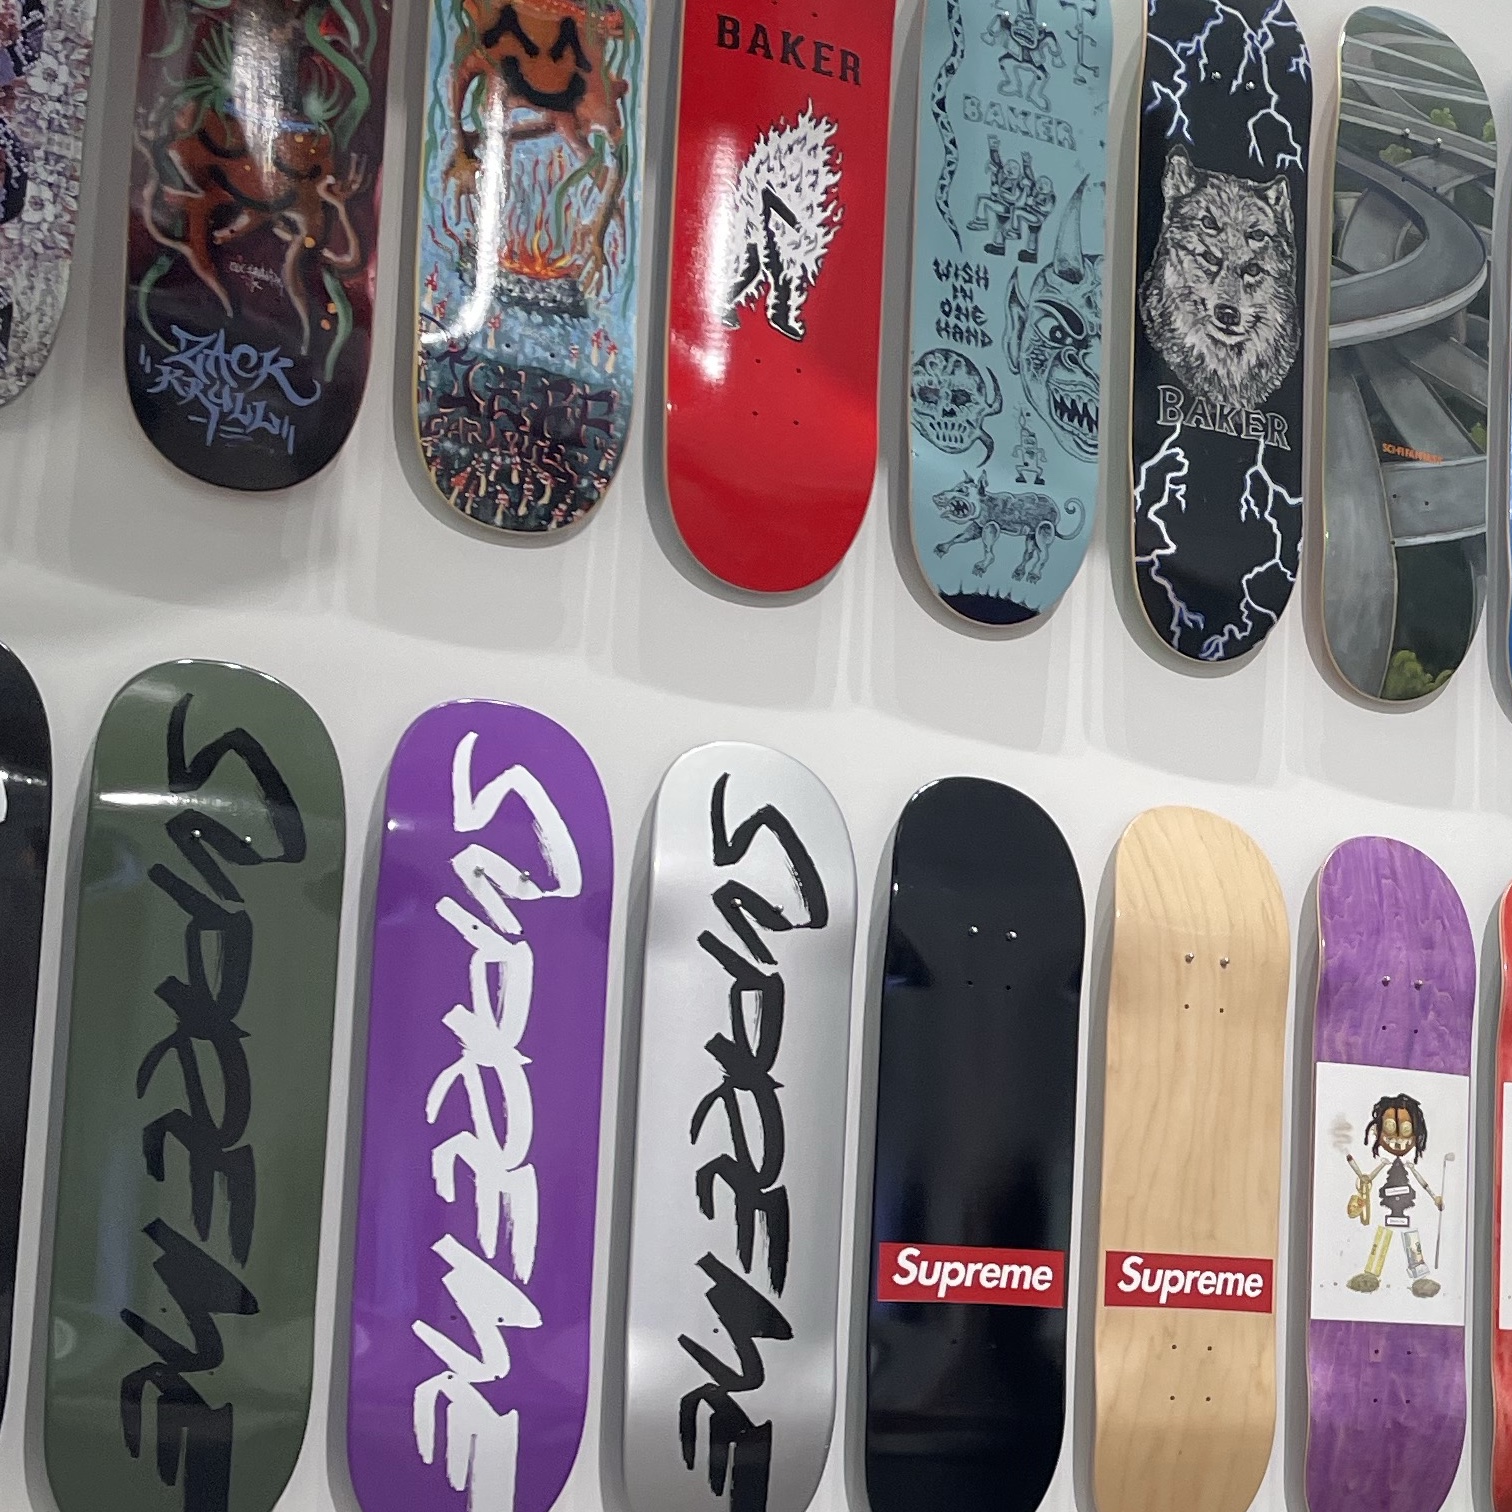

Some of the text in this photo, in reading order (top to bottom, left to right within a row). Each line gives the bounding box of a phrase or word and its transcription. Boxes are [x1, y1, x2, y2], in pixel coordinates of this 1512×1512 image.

[716, 13, 861, 86] BAKER
[962, 93, 1078, 152] BAKER
[933, 257, 990, 291] WISH
[951, 283, 974, 304] IN
[935, 318, 994, 348] HAND
[939, 298, 989, 327] ONE
[163, 324, 321, 407] ZACK
[1157, 384, 1291, 451] BAKER
[892, 1247, 1054, 1298] Supreme
[1117, 1256, 1265, 1305] Supreme
